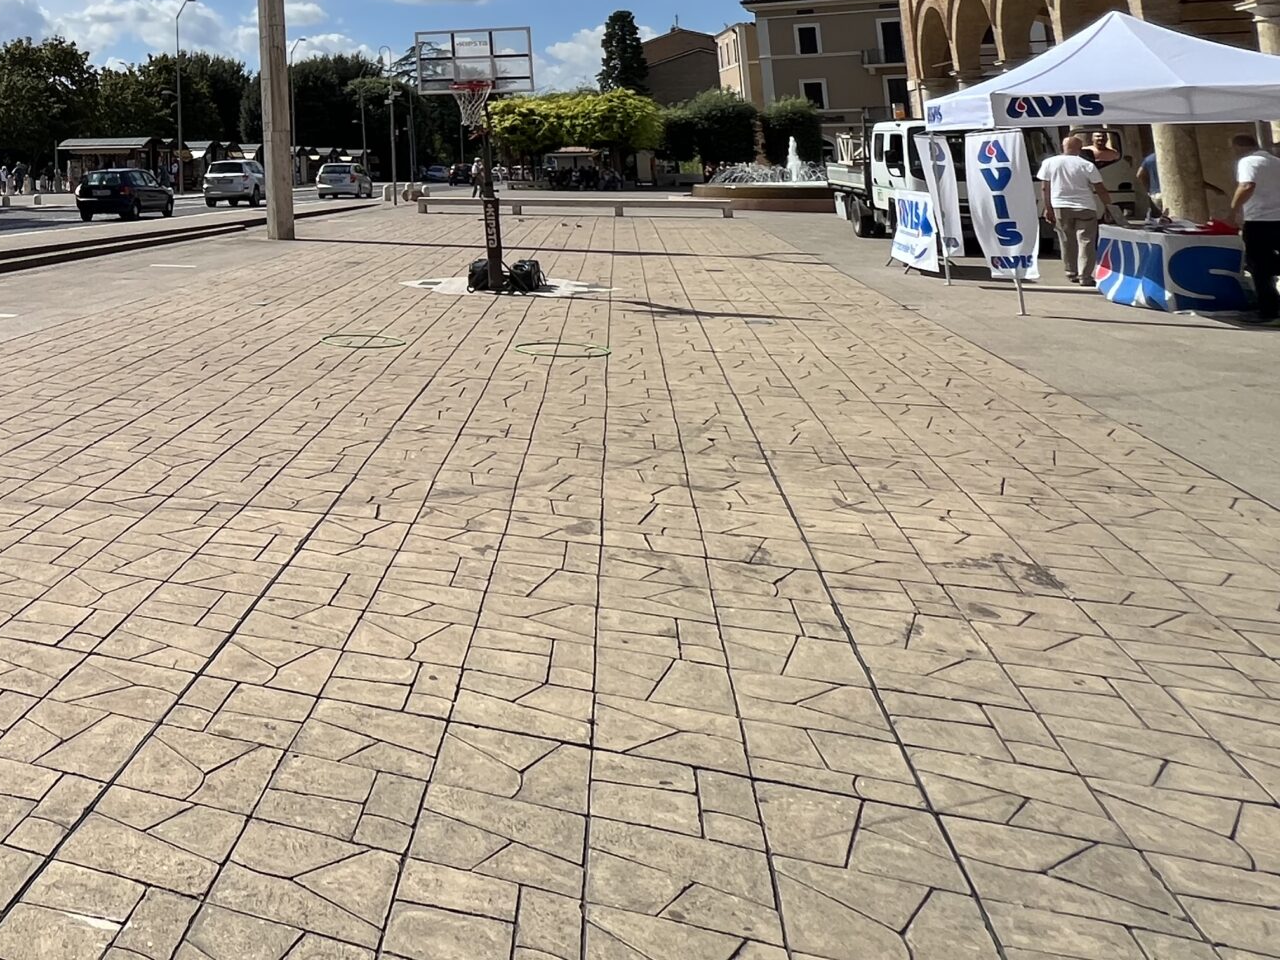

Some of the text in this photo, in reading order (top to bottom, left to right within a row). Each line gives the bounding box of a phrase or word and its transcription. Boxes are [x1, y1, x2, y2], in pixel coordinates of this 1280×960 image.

[1006, 94, 1104, 119] AVIS
[977, 139, 1024, 246] AVIS
[486, 207, 497, 248] KIPSTA
[991, 255, 1033, 269] AVIS
[1095, 238, 1251, 311] AVIS
